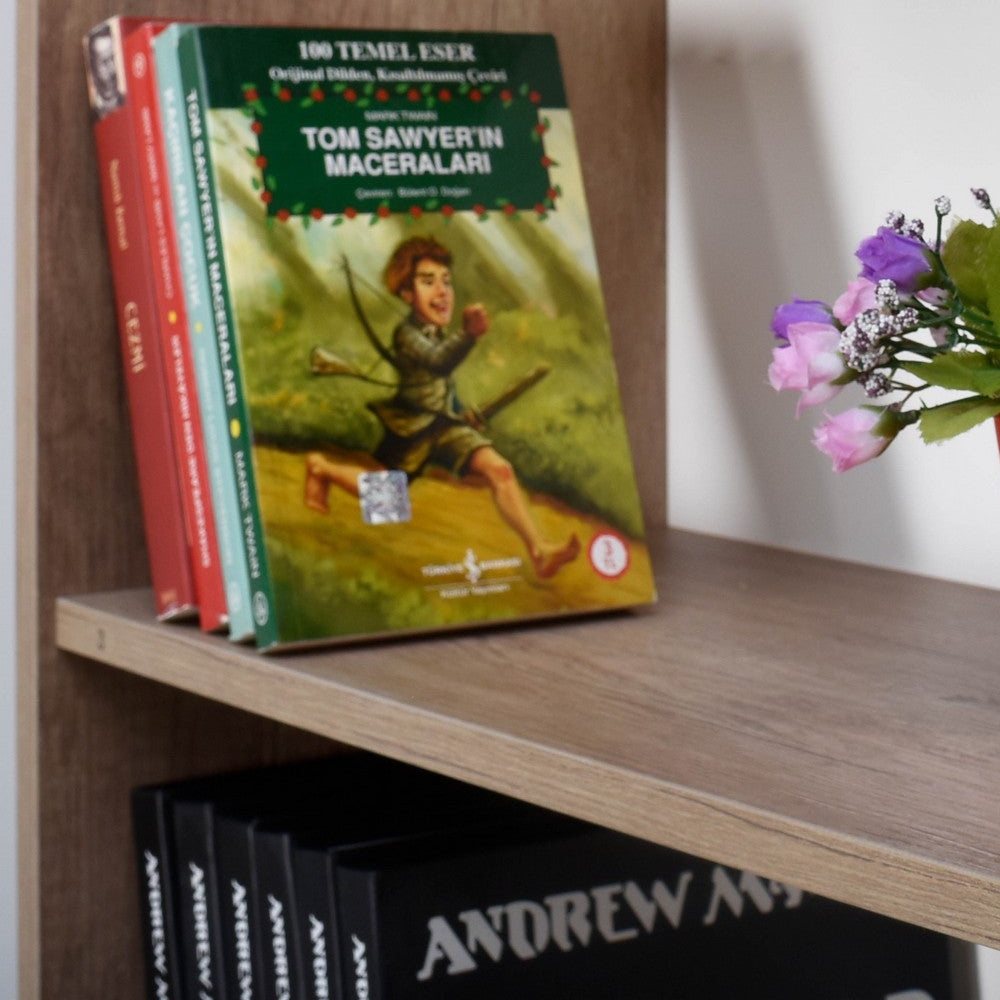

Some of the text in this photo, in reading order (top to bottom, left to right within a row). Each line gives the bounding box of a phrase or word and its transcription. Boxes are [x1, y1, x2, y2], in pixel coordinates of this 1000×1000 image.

[298, 40, 478, 62] 100 TEMEL ESER
[186, 88, 202, 138] TOM
[301, 126, 504, 151] TOM SAWYER'IN
[324, 152, 491, 177] MACERALARI
[193, 139, 217, 260] SAWYER'IN
[208, 262, 237, 406] MACERALARI
[234, 451, 261, 578] MARK TWAIN
[144, 850, 168, 975] ANDREW
[188, 861, 213, 990] ANDREW
[267, 893, 291, 1000] ANDRE
[416, 871, 693, 980] ANDREW
